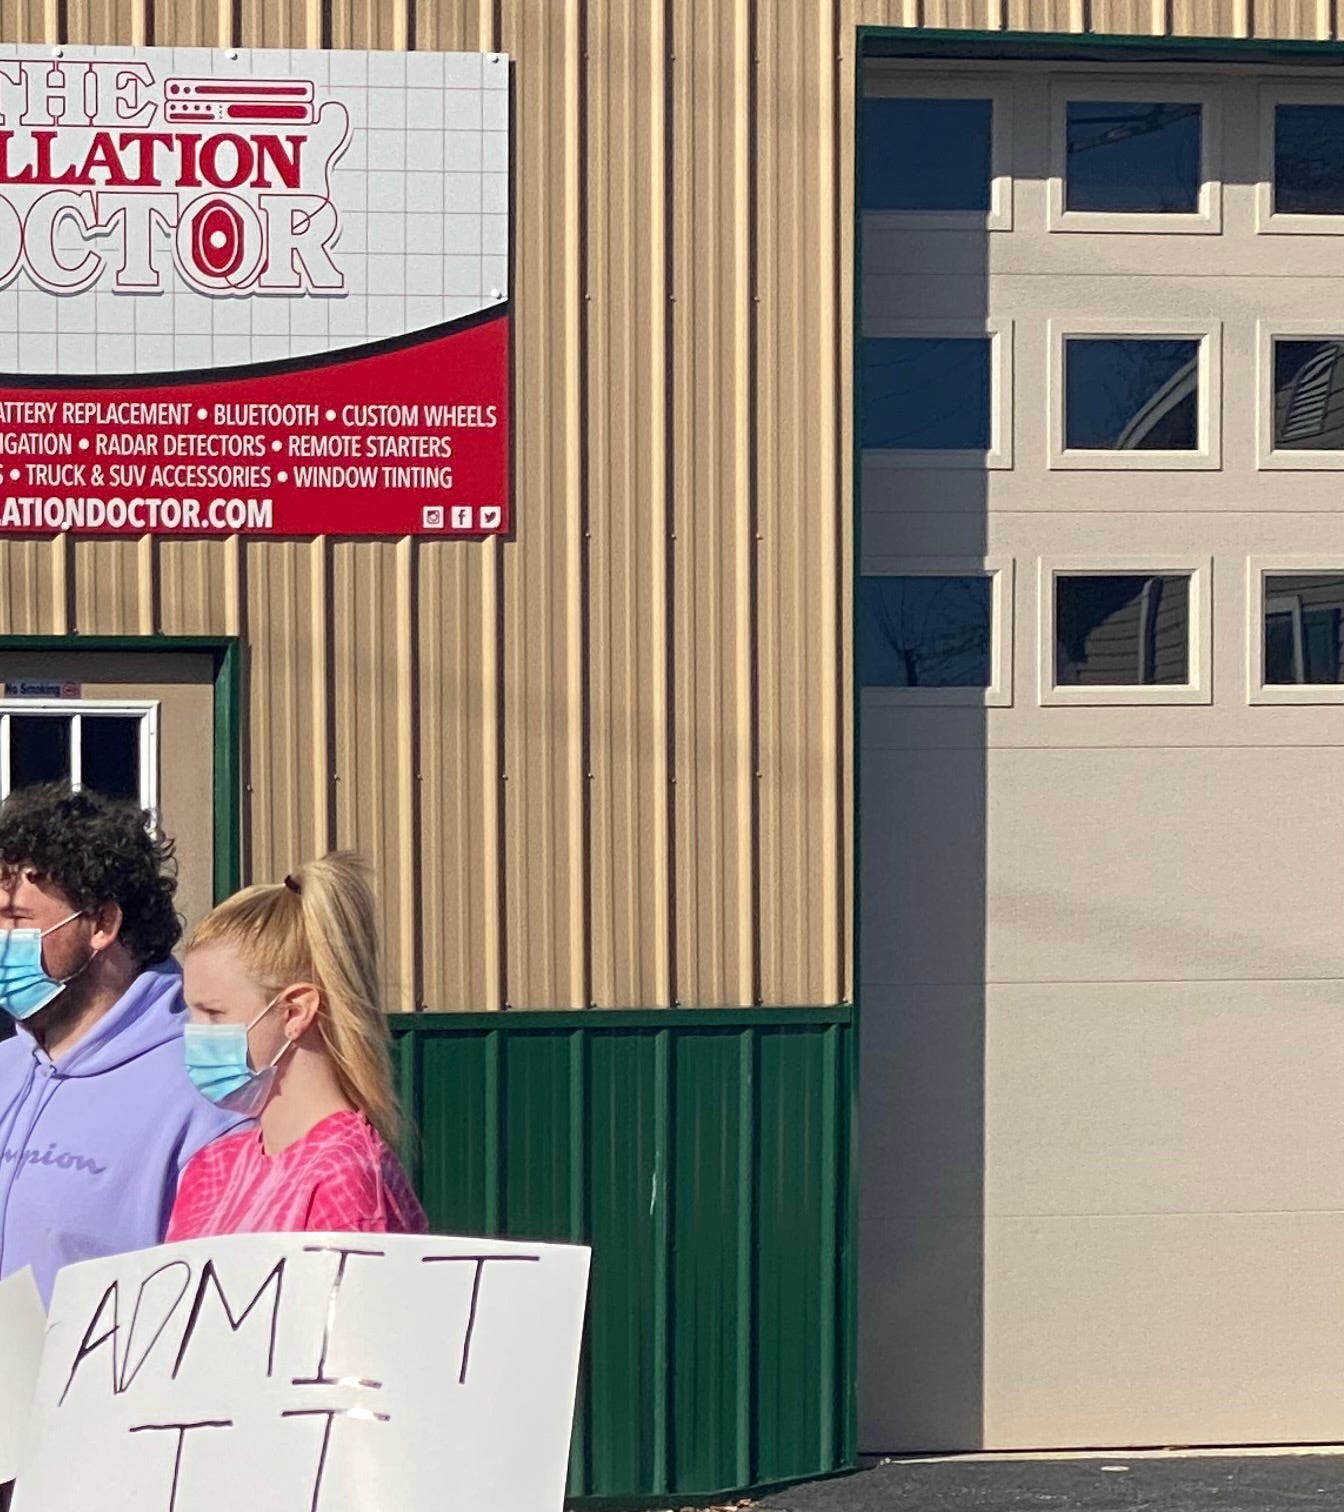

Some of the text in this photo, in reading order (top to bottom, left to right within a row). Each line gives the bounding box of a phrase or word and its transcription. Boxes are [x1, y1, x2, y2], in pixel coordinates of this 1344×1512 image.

[62, 402, 192, 425] REPLACEMENT
[214, 403, 319, 426] BLUETOOTH
[342, 404, 418, 427] CUSTOM
[424, 405, 497, 428] WHEELS
[95, 434, 157, 456] RADAR
[163, 434, 266, 457] DETECTORS
[288, 435, 361, 458] REMOTE
[366, 435, 452, 458] STARTERS
[24, 464, 86, 487] TRUCK
[91, 464, 104, 487] &
[109, 465, 146, 488] SUV
[150, 465, 271, 488] ACCESSORIES
[293, 466, 378, 489] WINDOW
[381, 467, 453, 489] TINTING
[58, 1247, 541, 1407] ADMIT
